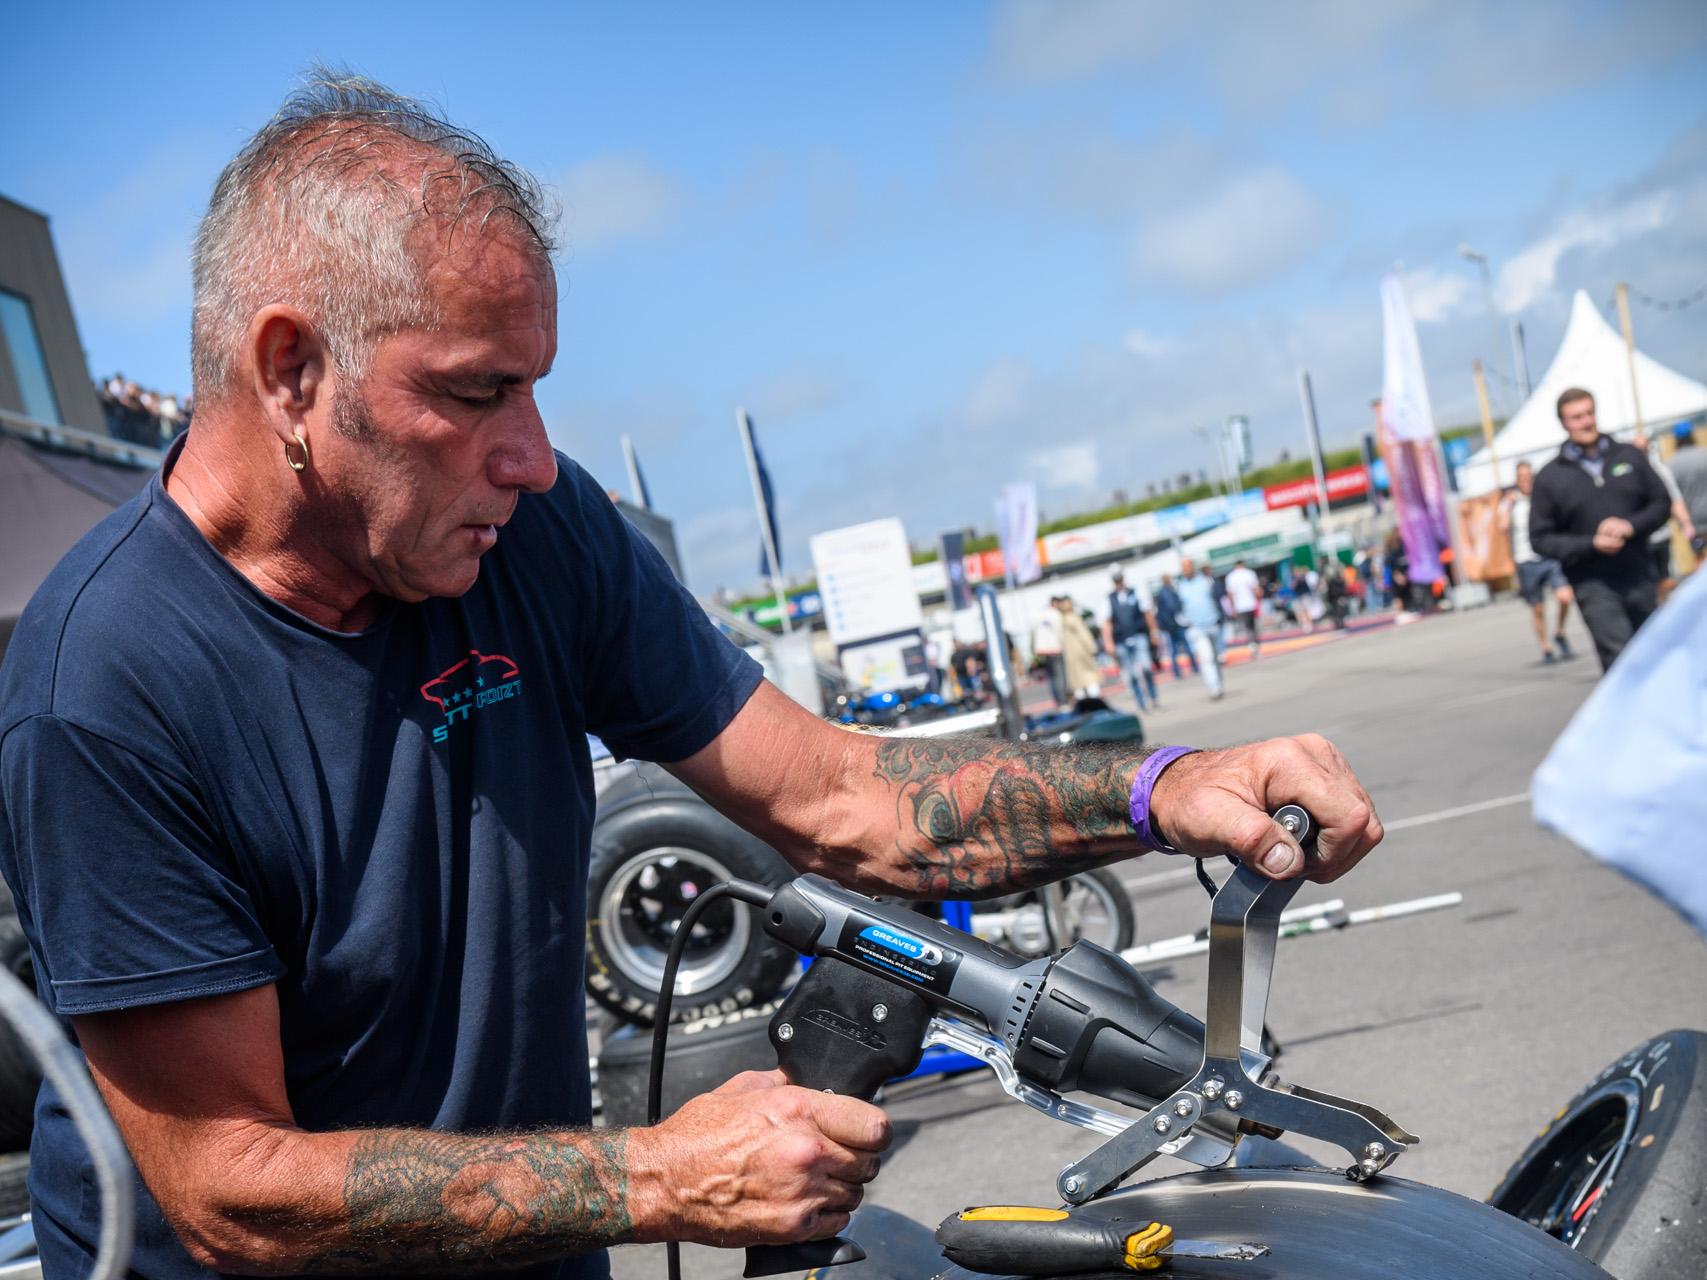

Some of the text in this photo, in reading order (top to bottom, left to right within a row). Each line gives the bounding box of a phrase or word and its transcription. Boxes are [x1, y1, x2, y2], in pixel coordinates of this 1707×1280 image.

[853, 936, 937, 976] ENGINEERING
[872, 929, 917, 953] GREAVES
[855, 944, 935, 981] PROFESSIONAL PIT EQUIPMENT
[862, 953, 924, 983] WWW.GREAVES3D.COM
